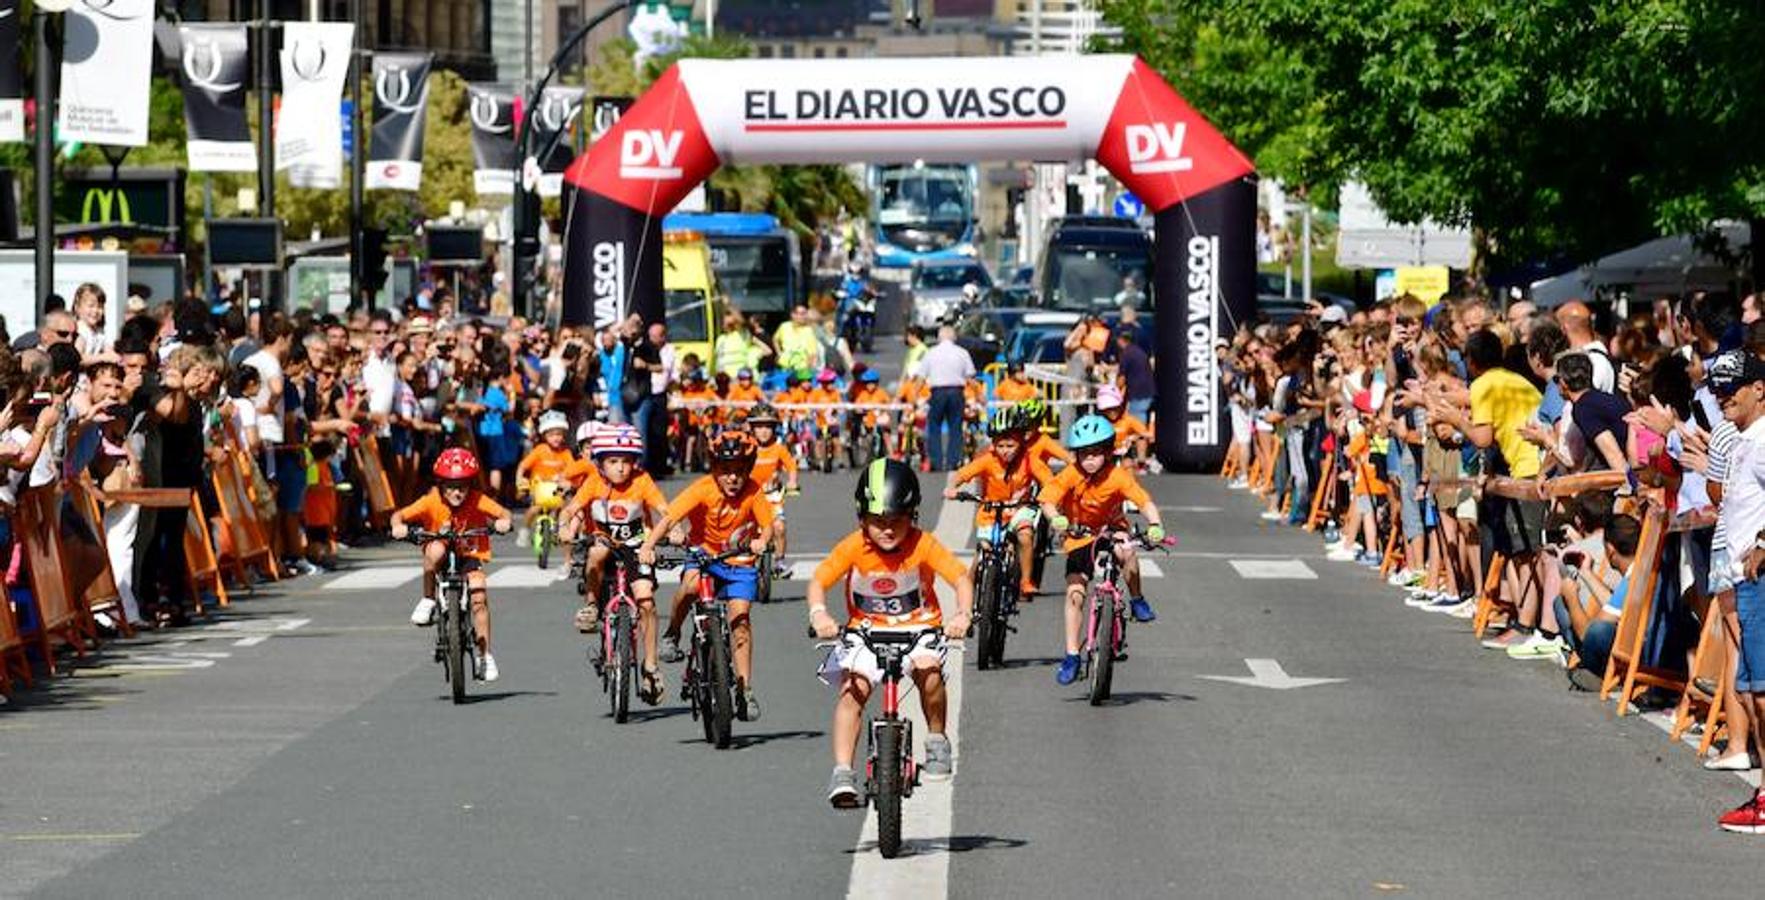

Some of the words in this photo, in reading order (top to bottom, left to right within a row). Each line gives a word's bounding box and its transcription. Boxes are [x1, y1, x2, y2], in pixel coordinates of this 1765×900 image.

[745, 90, 788, 120] EL
[796, 88, 930, 120] DIARIO
[937, 86, 1067, 118] VASCO
[621, 129, 685, 166] DV
[1125, 121, 1188, 161] DV
[593, 241, 617, 330] VASCO
[1187, 235, 1211, 323] VASCO
[1187, 323, 1211, 413] DIARIO
[1187, 413, 1211, 445] EL
[609, 524, 632, 539] 78
[872, 598, 903, 615] 33
